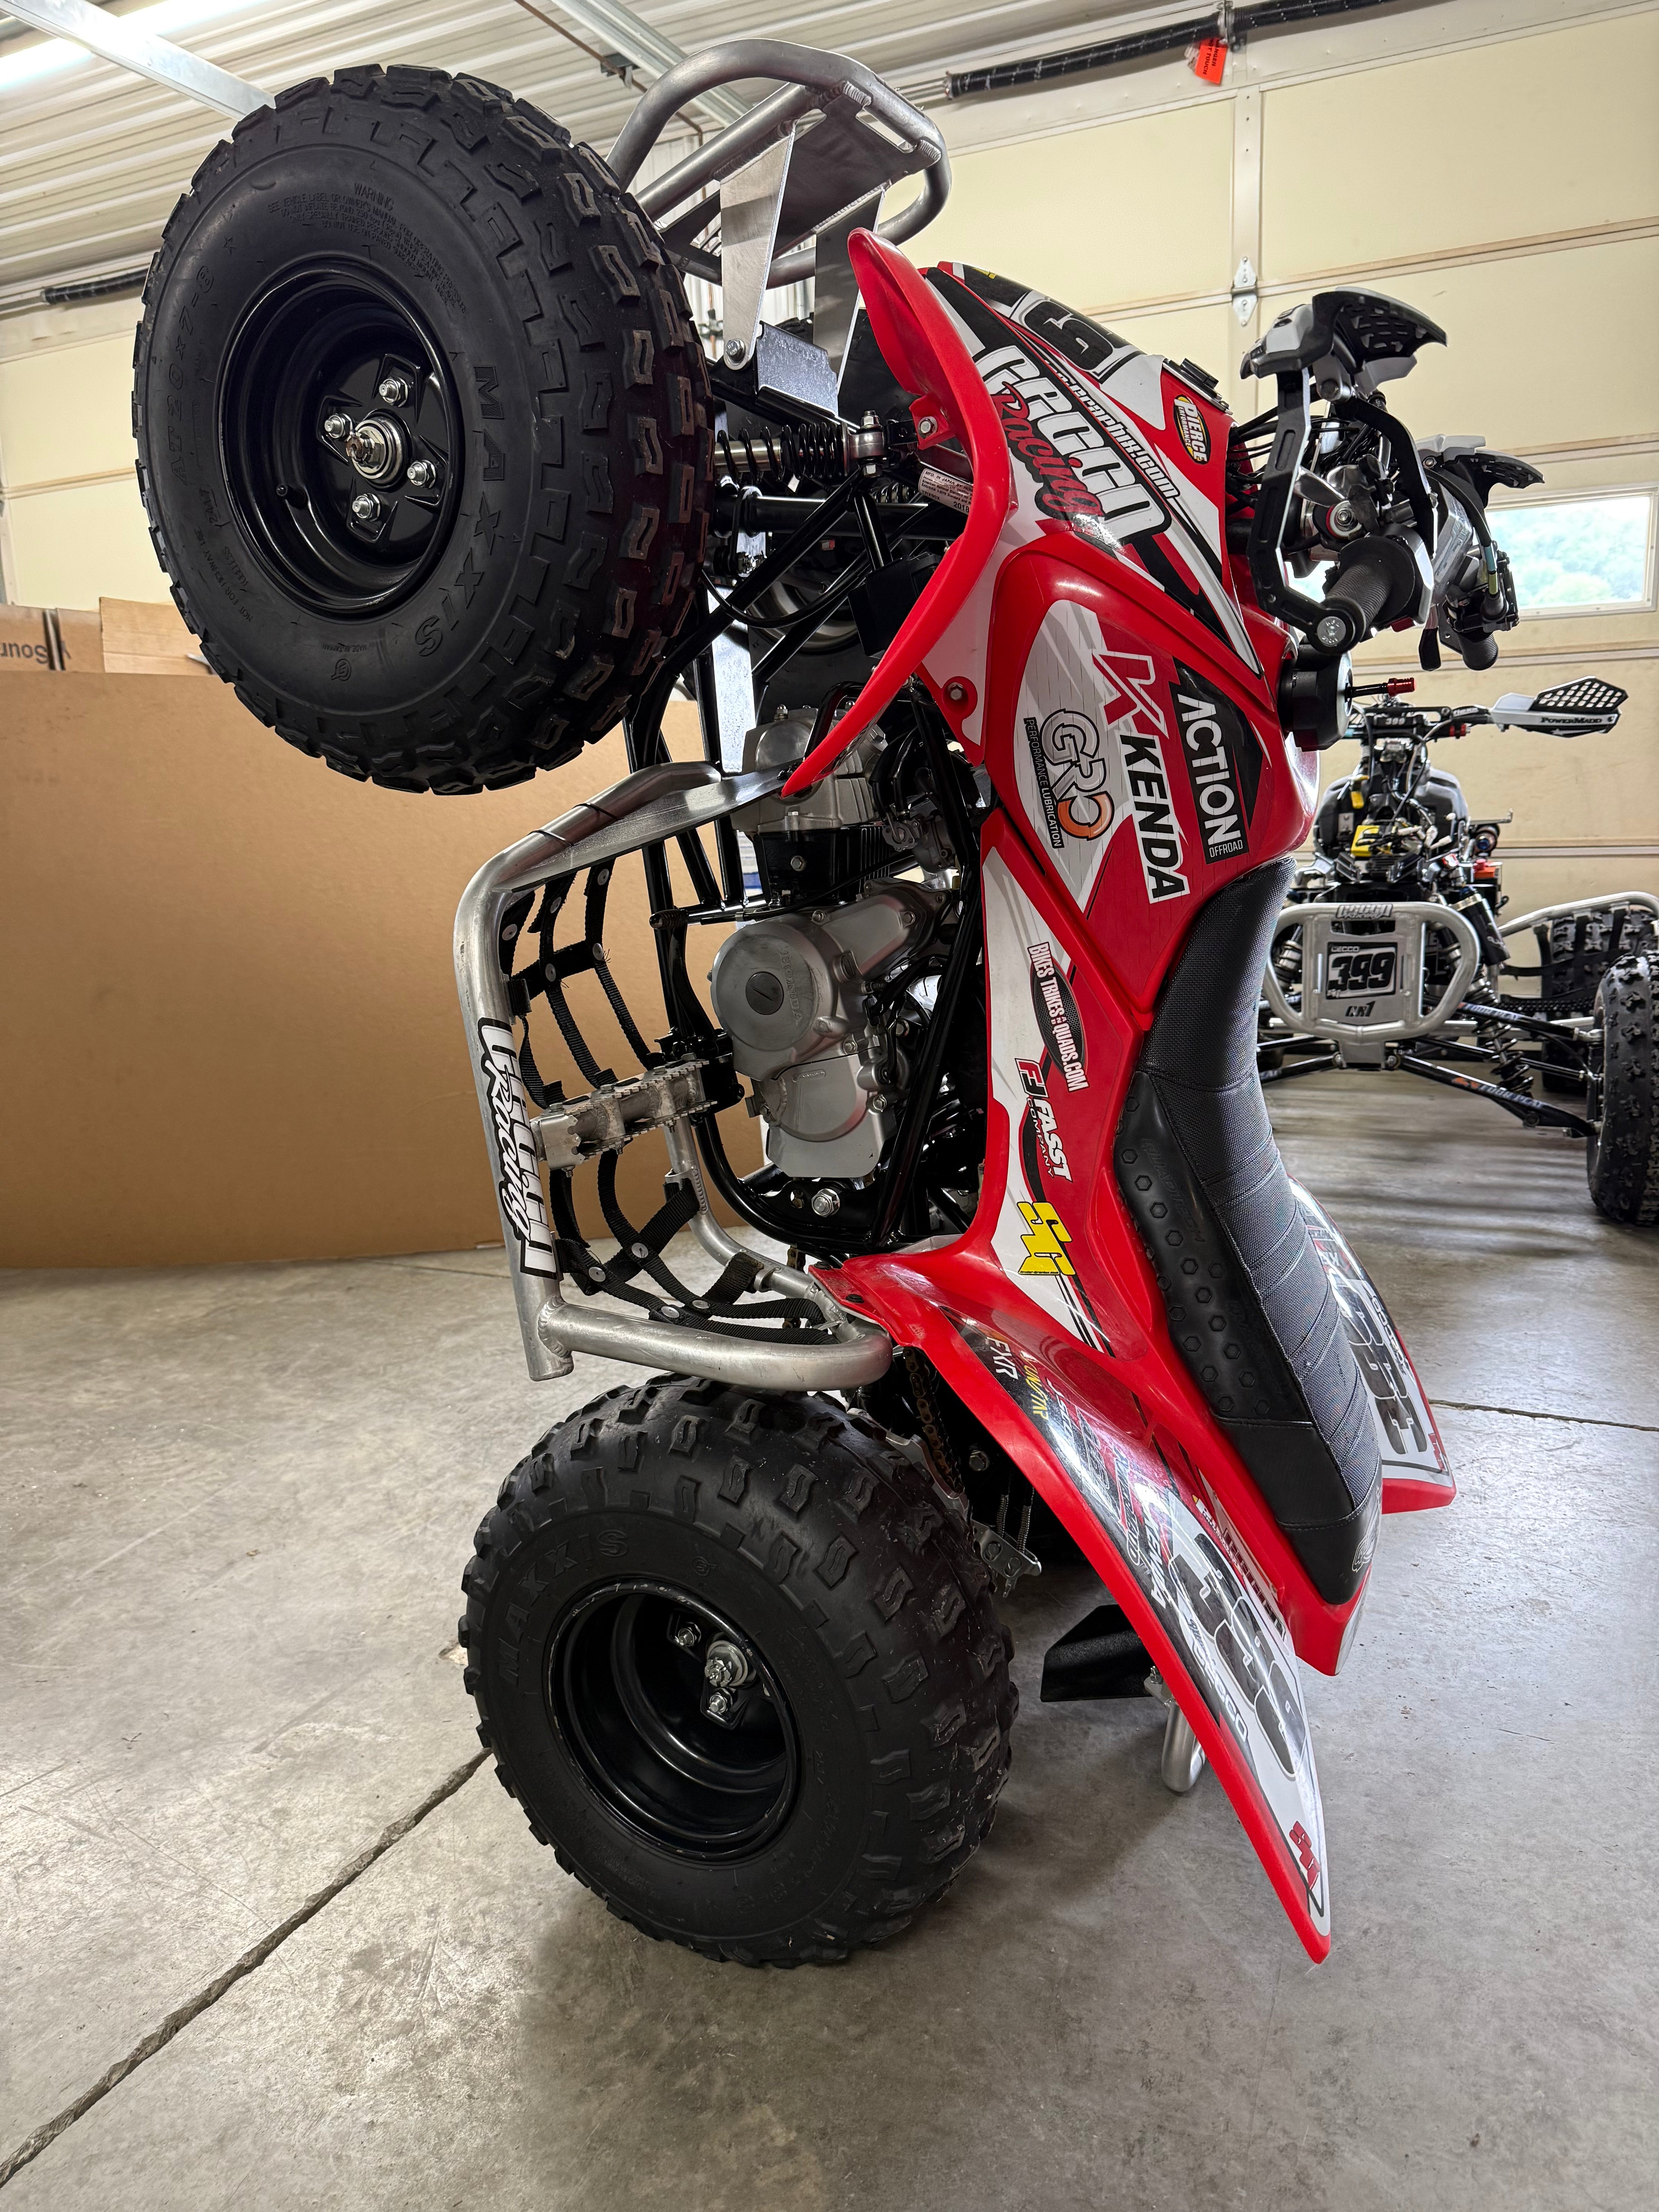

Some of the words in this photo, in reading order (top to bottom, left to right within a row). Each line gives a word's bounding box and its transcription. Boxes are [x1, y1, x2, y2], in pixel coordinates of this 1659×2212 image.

[354, 182, 395, 211] WARNING
[373, 205, 397, 227] MANUAL
[398, 223, 413, 240] FOR
[412, 234, 445, 276] OPERATING
[990, 383, 1104, 519] Racing
[1176, 398, 1207, 465] PIERCE
[418, 363, 507, 657] MAXXIS
[952, 501, 970, 512] 2018
[224, 584, 239, 608] FOR
[1025, 717, 1048, 787] PERFORMANCE
[1042, 787, 1063, 848] LUBRICATION
[1178, 693, 1241, 846] ACTION
[1120, 734, 1186, 900] KENDA
[1209, 839, 1244, 859] OFFROAD
[779, 951, 803, 1027] HONDA
[1328, 951, 1395, 993] 399
[1028, 944, 1054, 978] BIKES
[1041, 976, 1061, 1018] TRIKES
[1051, 1023, 1089, 1092] QUADS.COM
[484, 1059, 531, 1243] Racing
[1027, 1097, 1054, 1178] COMPANY
[1032, 1101, 1072, 1181] FASST
[1139, 1134, 1207, 1247] QUADTECH
[986, 1336, 1018, 1380] FXR
[1144, 1515, 1166, 1607] KENDA
[497, 1527, 629, 1686] MAXXIS
[1170, 1532, 1307, 1779] 399
